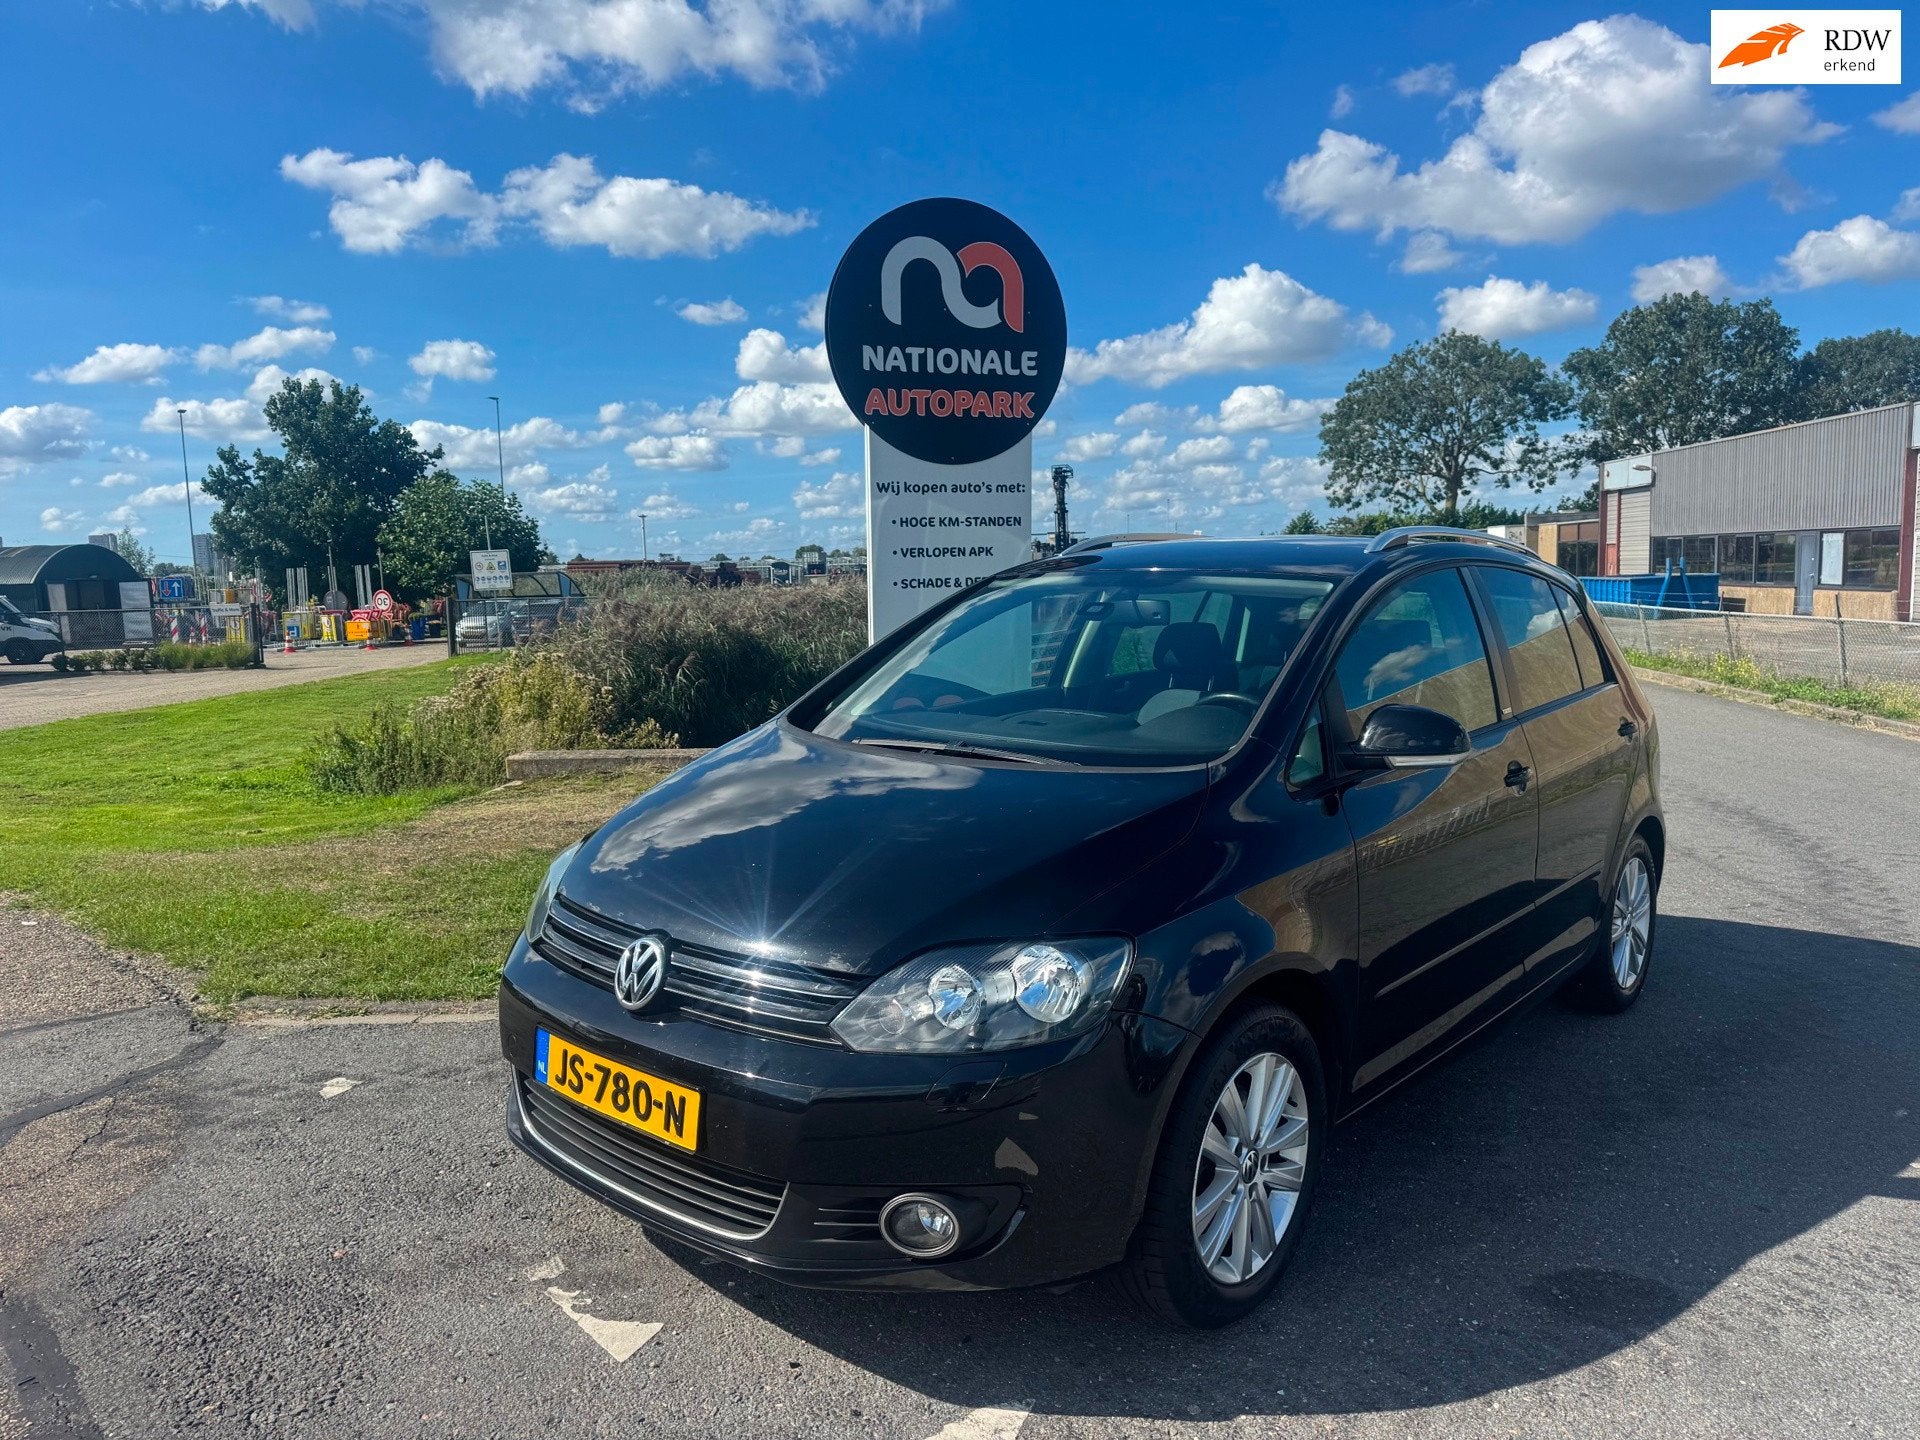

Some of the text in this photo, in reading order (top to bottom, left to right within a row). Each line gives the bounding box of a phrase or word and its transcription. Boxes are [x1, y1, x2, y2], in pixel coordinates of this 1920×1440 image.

[861, 344, 1039, 377] NATIONALE
[864, 387, 1036, 419] AUTOPARK
[876, 481, 900, 496] Wij
[903, 481, 948, 496] kopen
[995, 482, 1026, 494] met:
[900, 516, 1022, 528] HOGE KM-STANDEN
[900, 546, 994, 559] VERLOPEN APK
[900, 578, 951, 589] SCHADE
[953, 577, 963, 589] &
[537, 1059, 547, 1075] NL
[555, 1048, 687, 1139] JS-780-N
